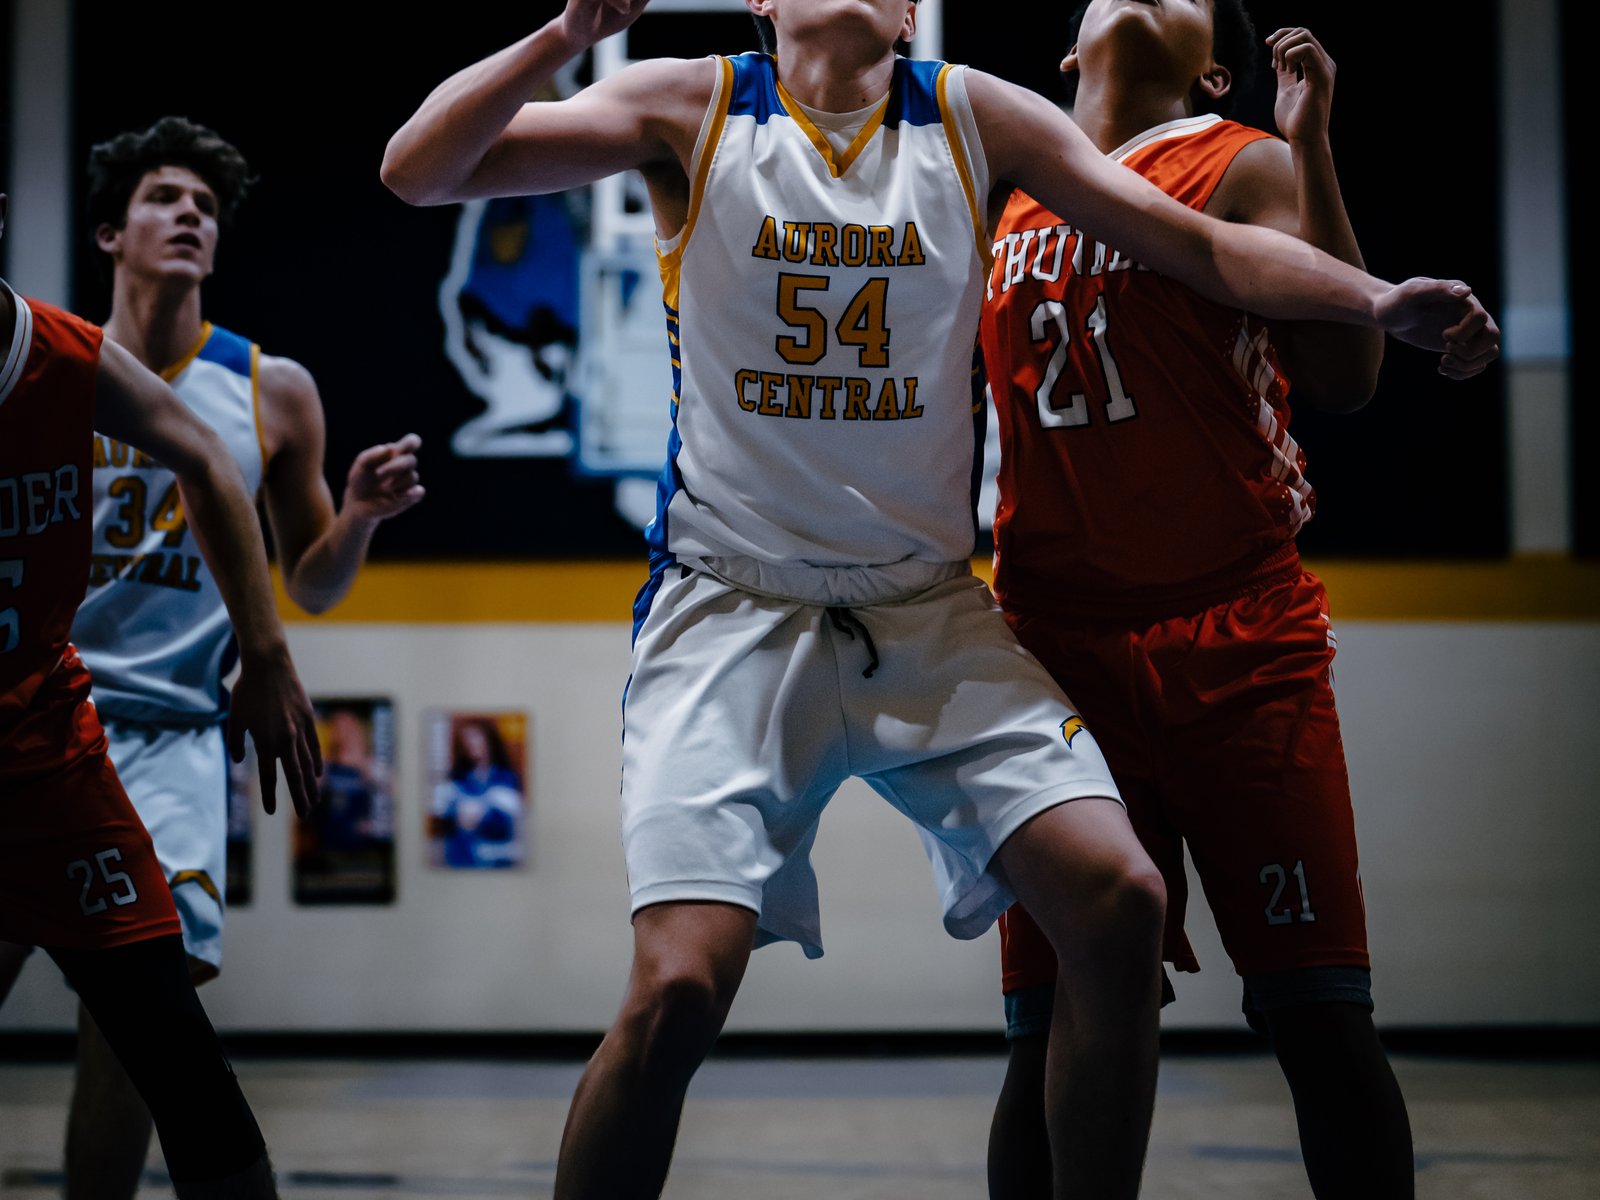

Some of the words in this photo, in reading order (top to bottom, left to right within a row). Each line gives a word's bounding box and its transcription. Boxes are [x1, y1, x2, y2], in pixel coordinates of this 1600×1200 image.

[752, 215, 925, 267] AURORA
[775, 272, 890, 368] 54
[735, 369, 924, 420] CENTRAL
[1029, 293, 1136, 431] 21
[105, 476, 189, 548] 34
[89, 553, 201, 591] ENTRAL
[66, 847, 138, 916] 25
[1258, 857, 1317, 927] 21
